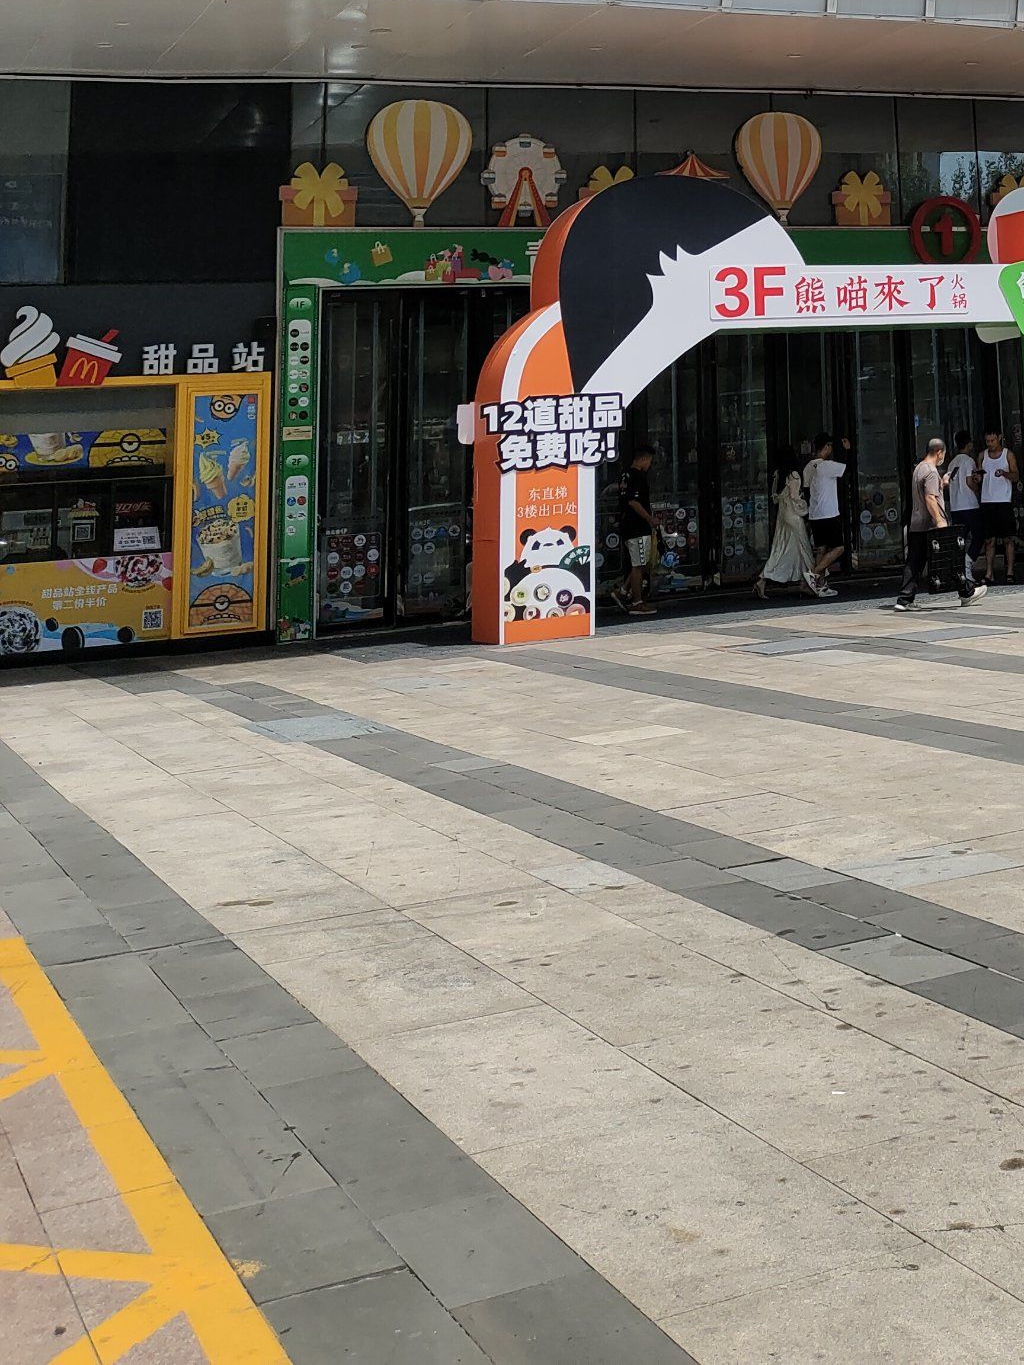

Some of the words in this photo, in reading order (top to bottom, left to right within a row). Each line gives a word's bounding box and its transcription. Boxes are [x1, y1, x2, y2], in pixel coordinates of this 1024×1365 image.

[714, 266, 787, 318] 3F
[951, 273, 968, 309] 火锅
[142, 341, 265, 375] 甜品站
[484, 396, 623, 432] 12道甜品
[517, 502, 577, 518] 3楼出口处
[528, 486, 568, 502] 东直梯
